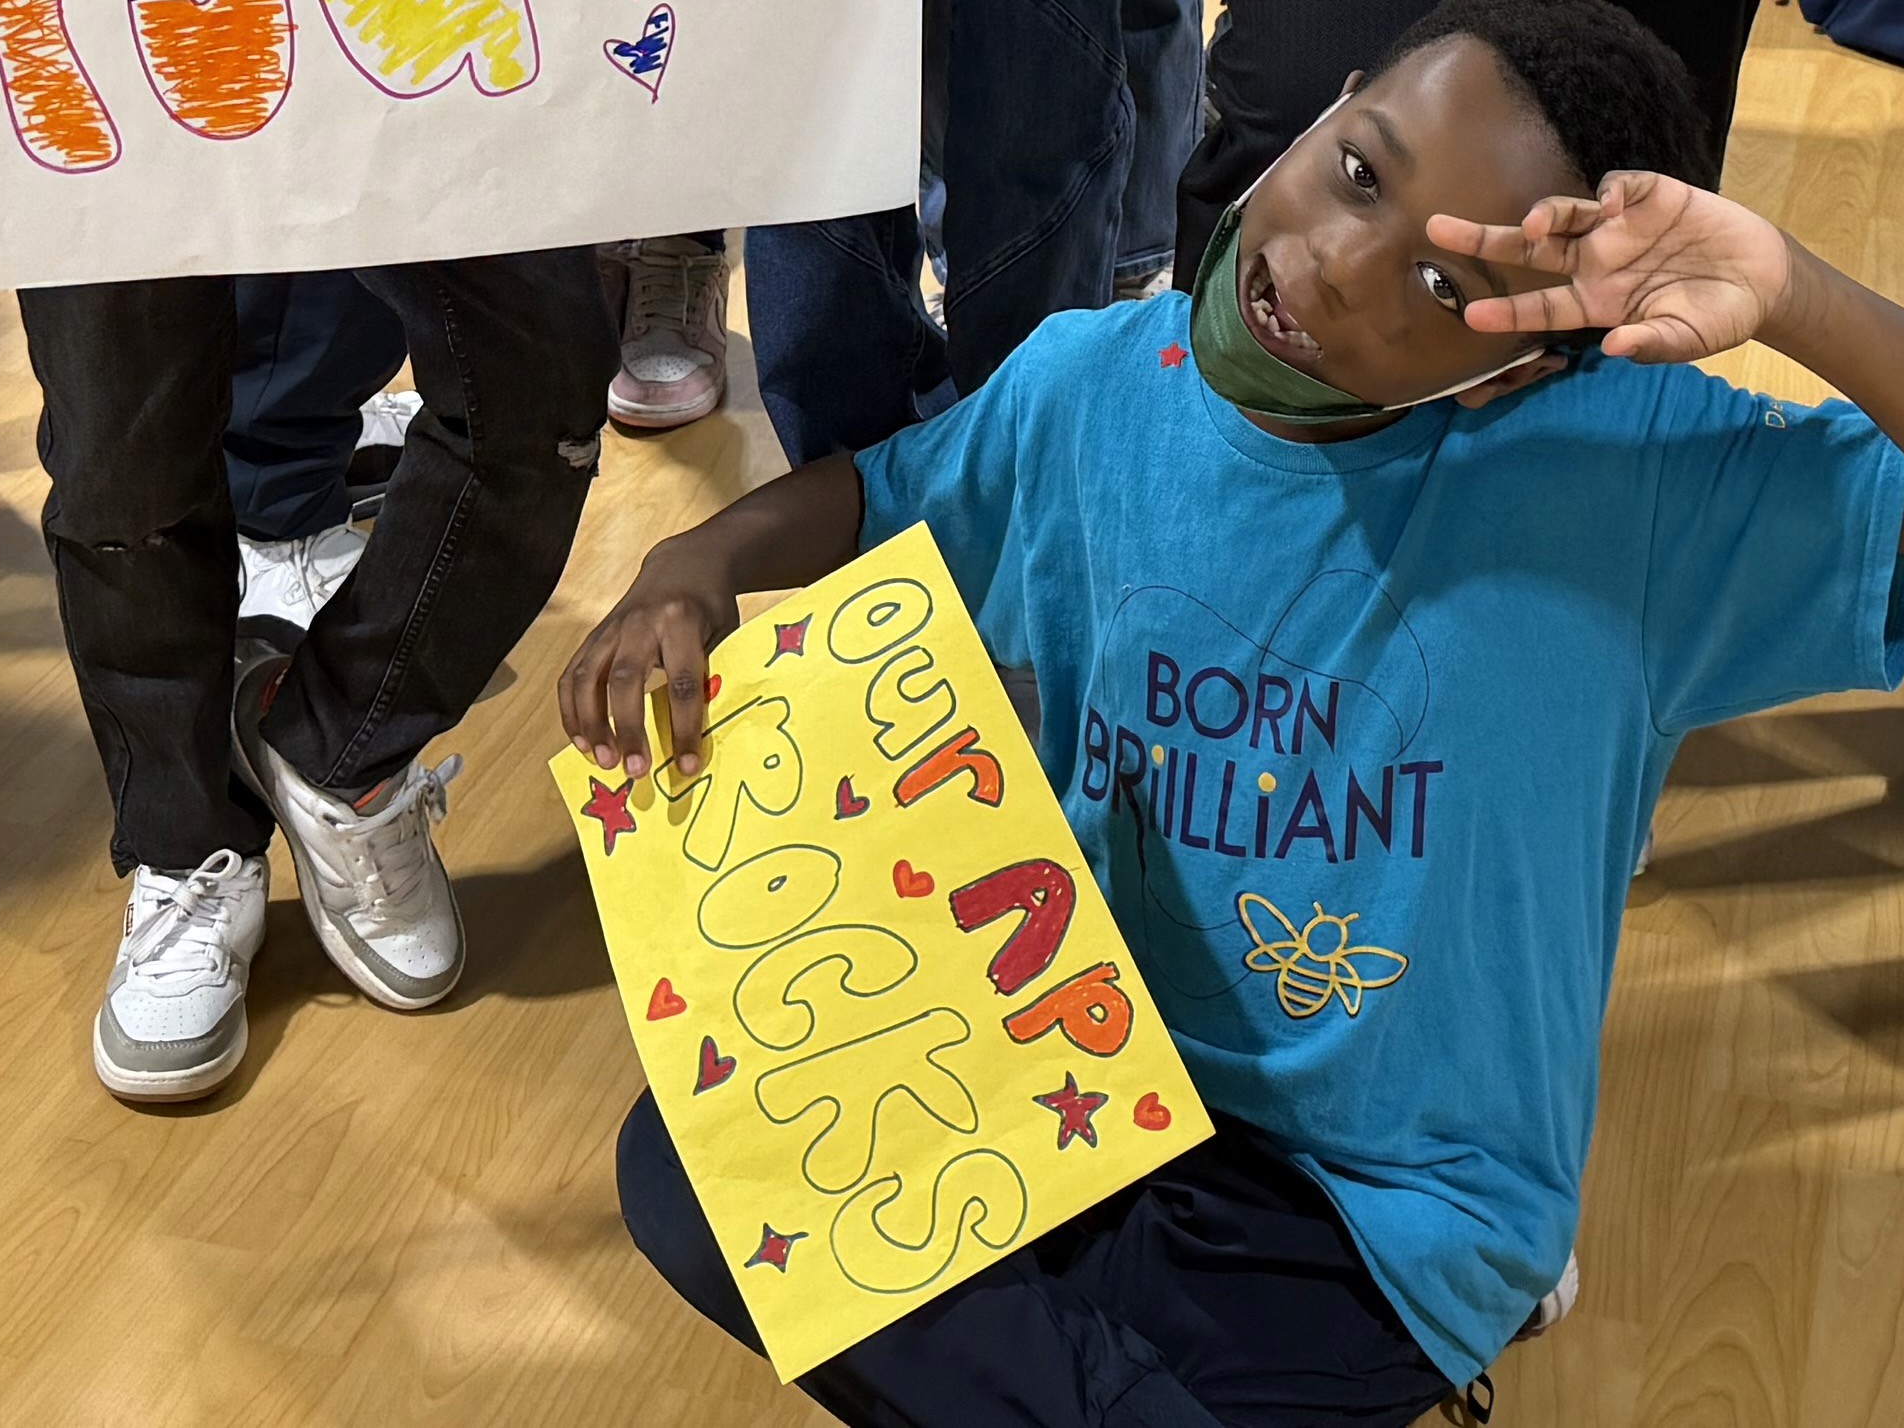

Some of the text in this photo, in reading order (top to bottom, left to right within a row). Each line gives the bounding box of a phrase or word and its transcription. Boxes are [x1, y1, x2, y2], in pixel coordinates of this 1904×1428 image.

[1146, 649, 1340, 756] BORN
[655, 694, 1029, 1295] ROCKS
[950, 857, 1134, 1058] AP
